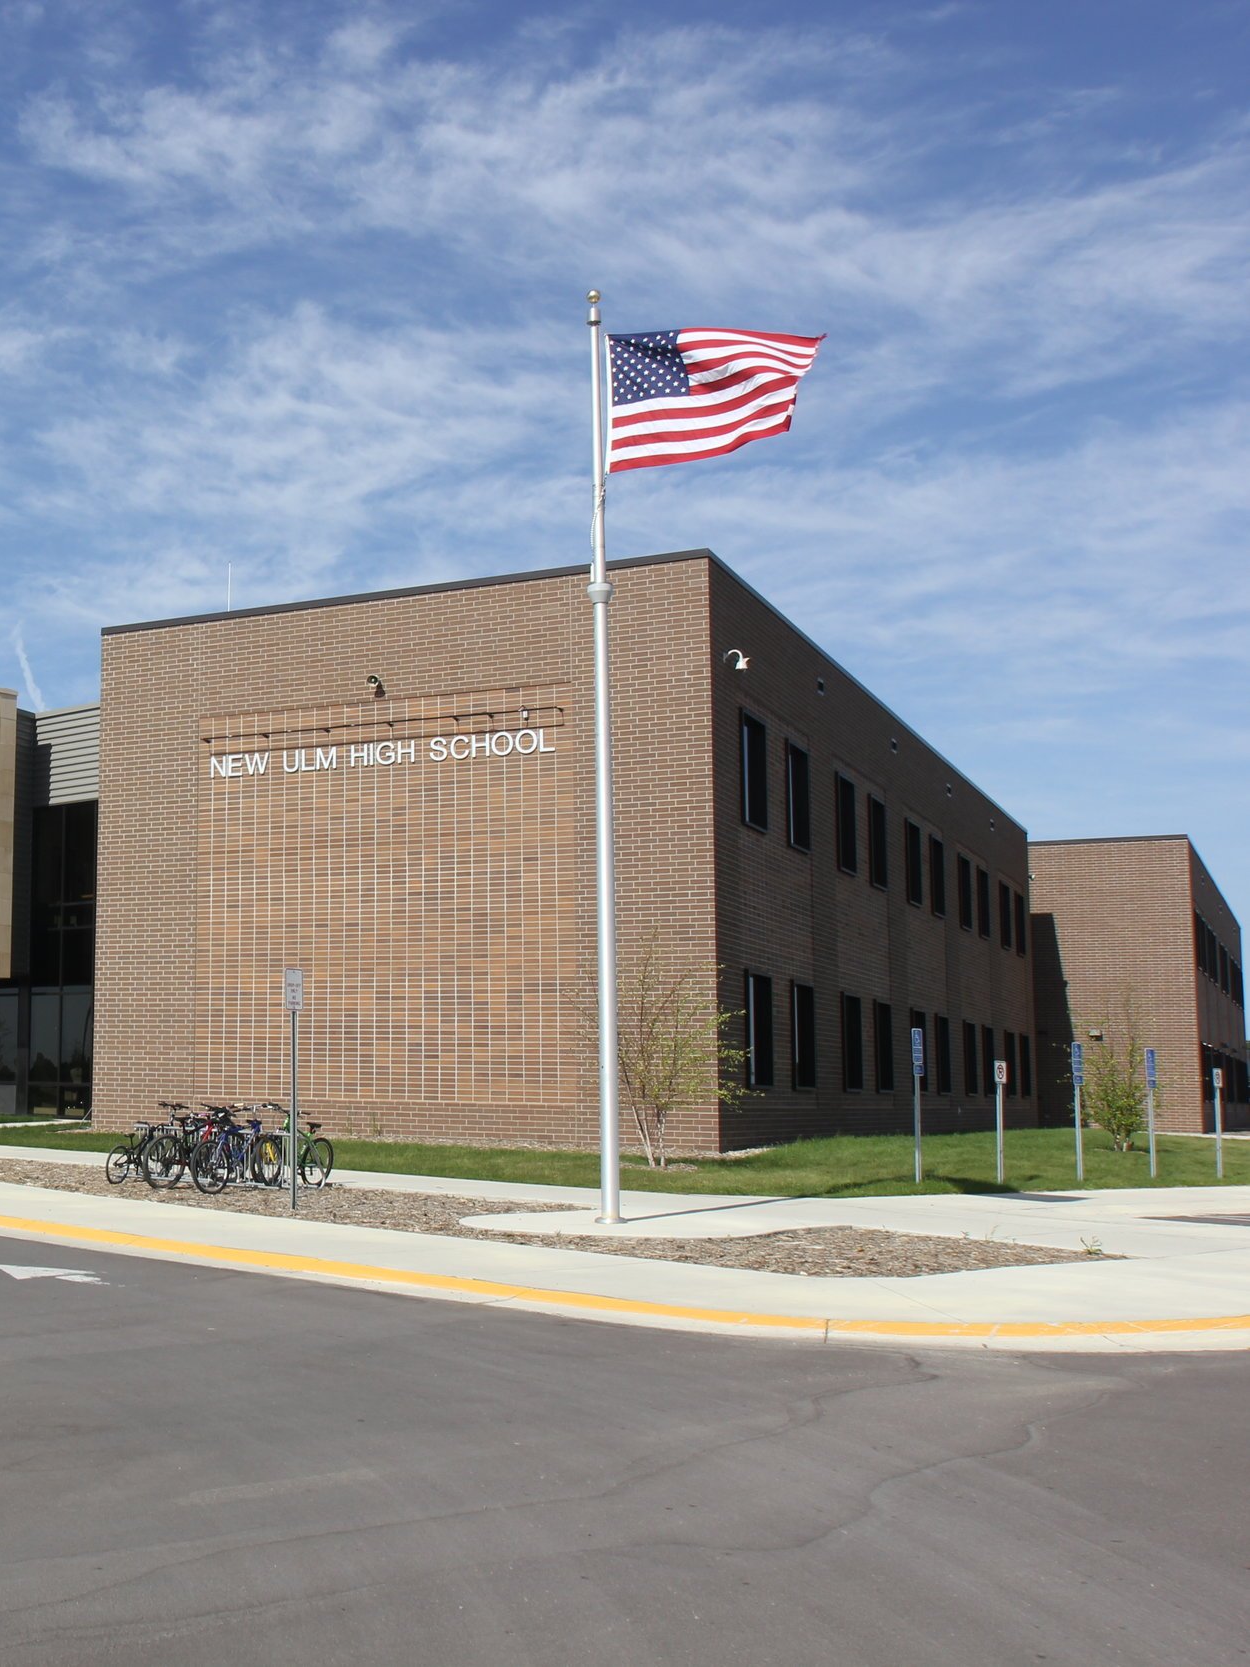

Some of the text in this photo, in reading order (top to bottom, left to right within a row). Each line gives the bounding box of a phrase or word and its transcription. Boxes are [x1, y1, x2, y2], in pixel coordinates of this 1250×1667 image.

[210, 729, 556, 778] NEW ULM HIGH SCHOOL
